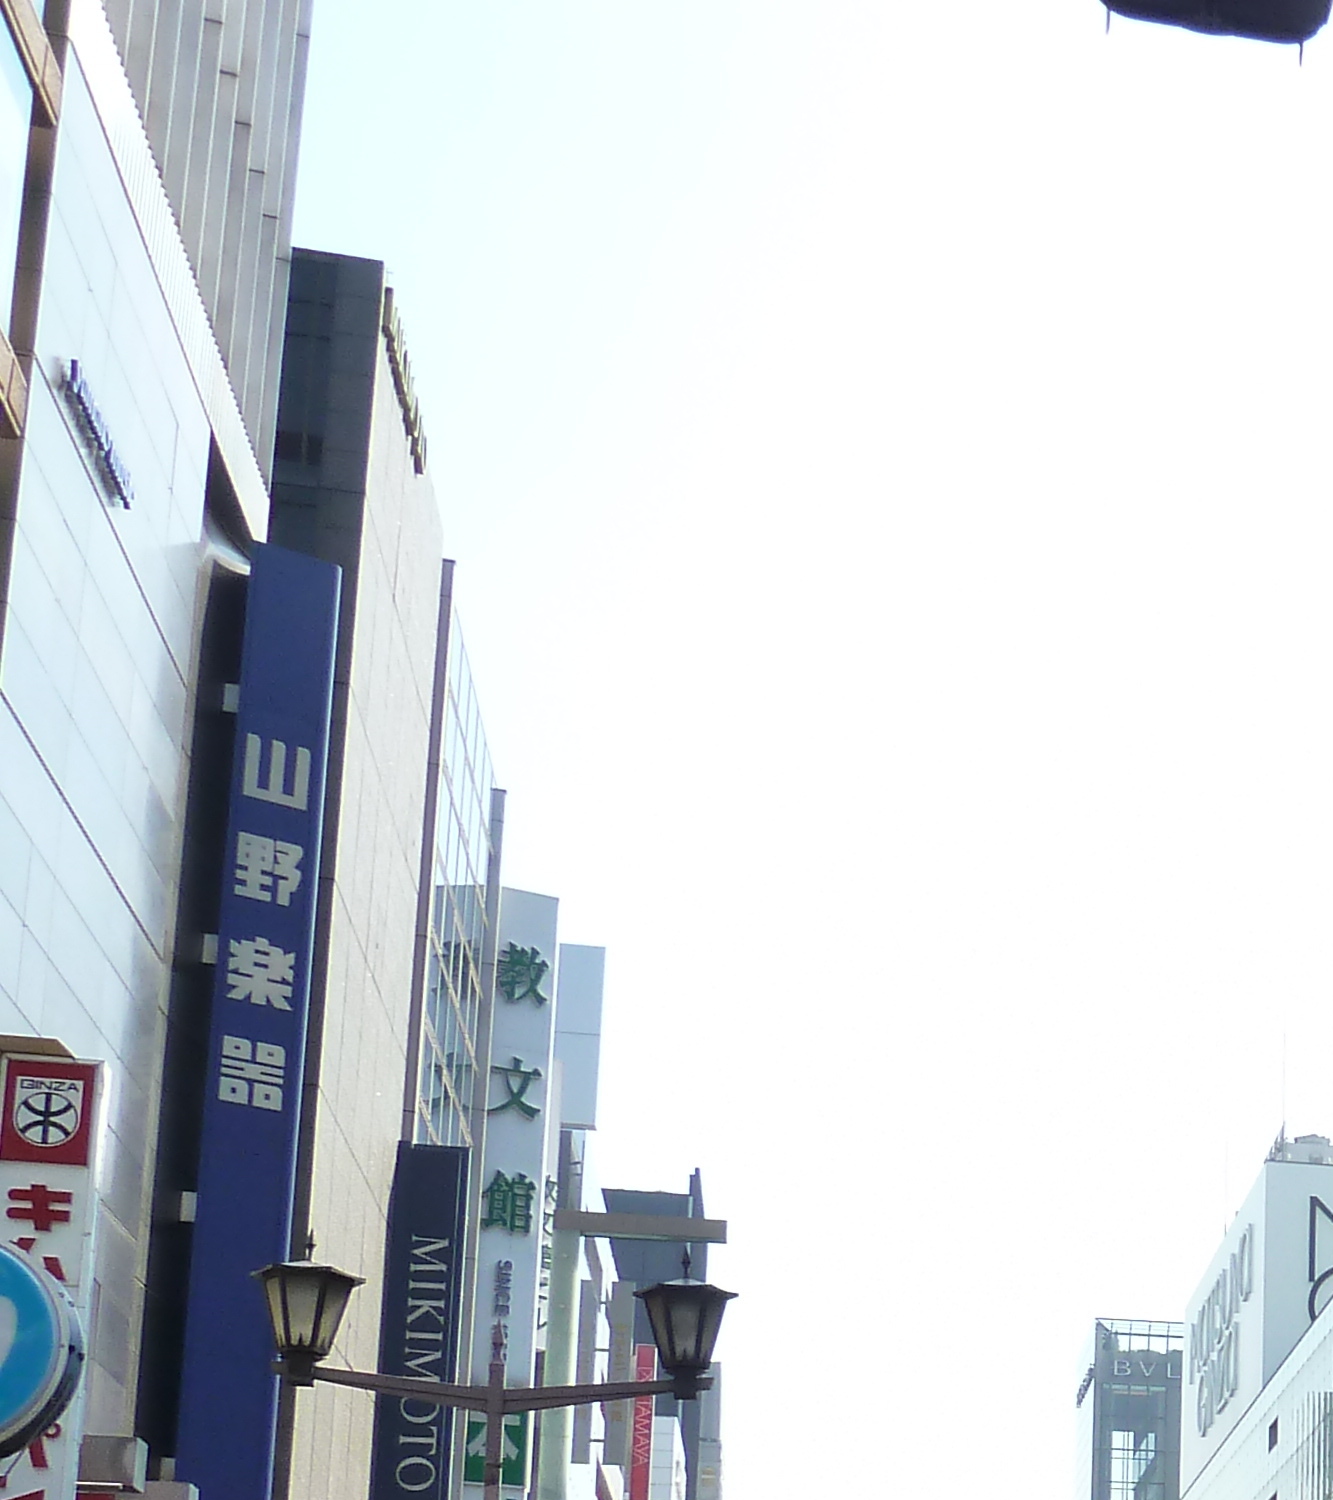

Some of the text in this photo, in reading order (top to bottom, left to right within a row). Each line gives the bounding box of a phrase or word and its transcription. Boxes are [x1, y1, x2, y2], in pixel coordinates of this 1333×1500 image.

[217, 732, 311, 1113] 山野楽器
[20, 1078, 80, 1093] GINZA
[395, 1233, 450, 1493] MIKIMOTO
